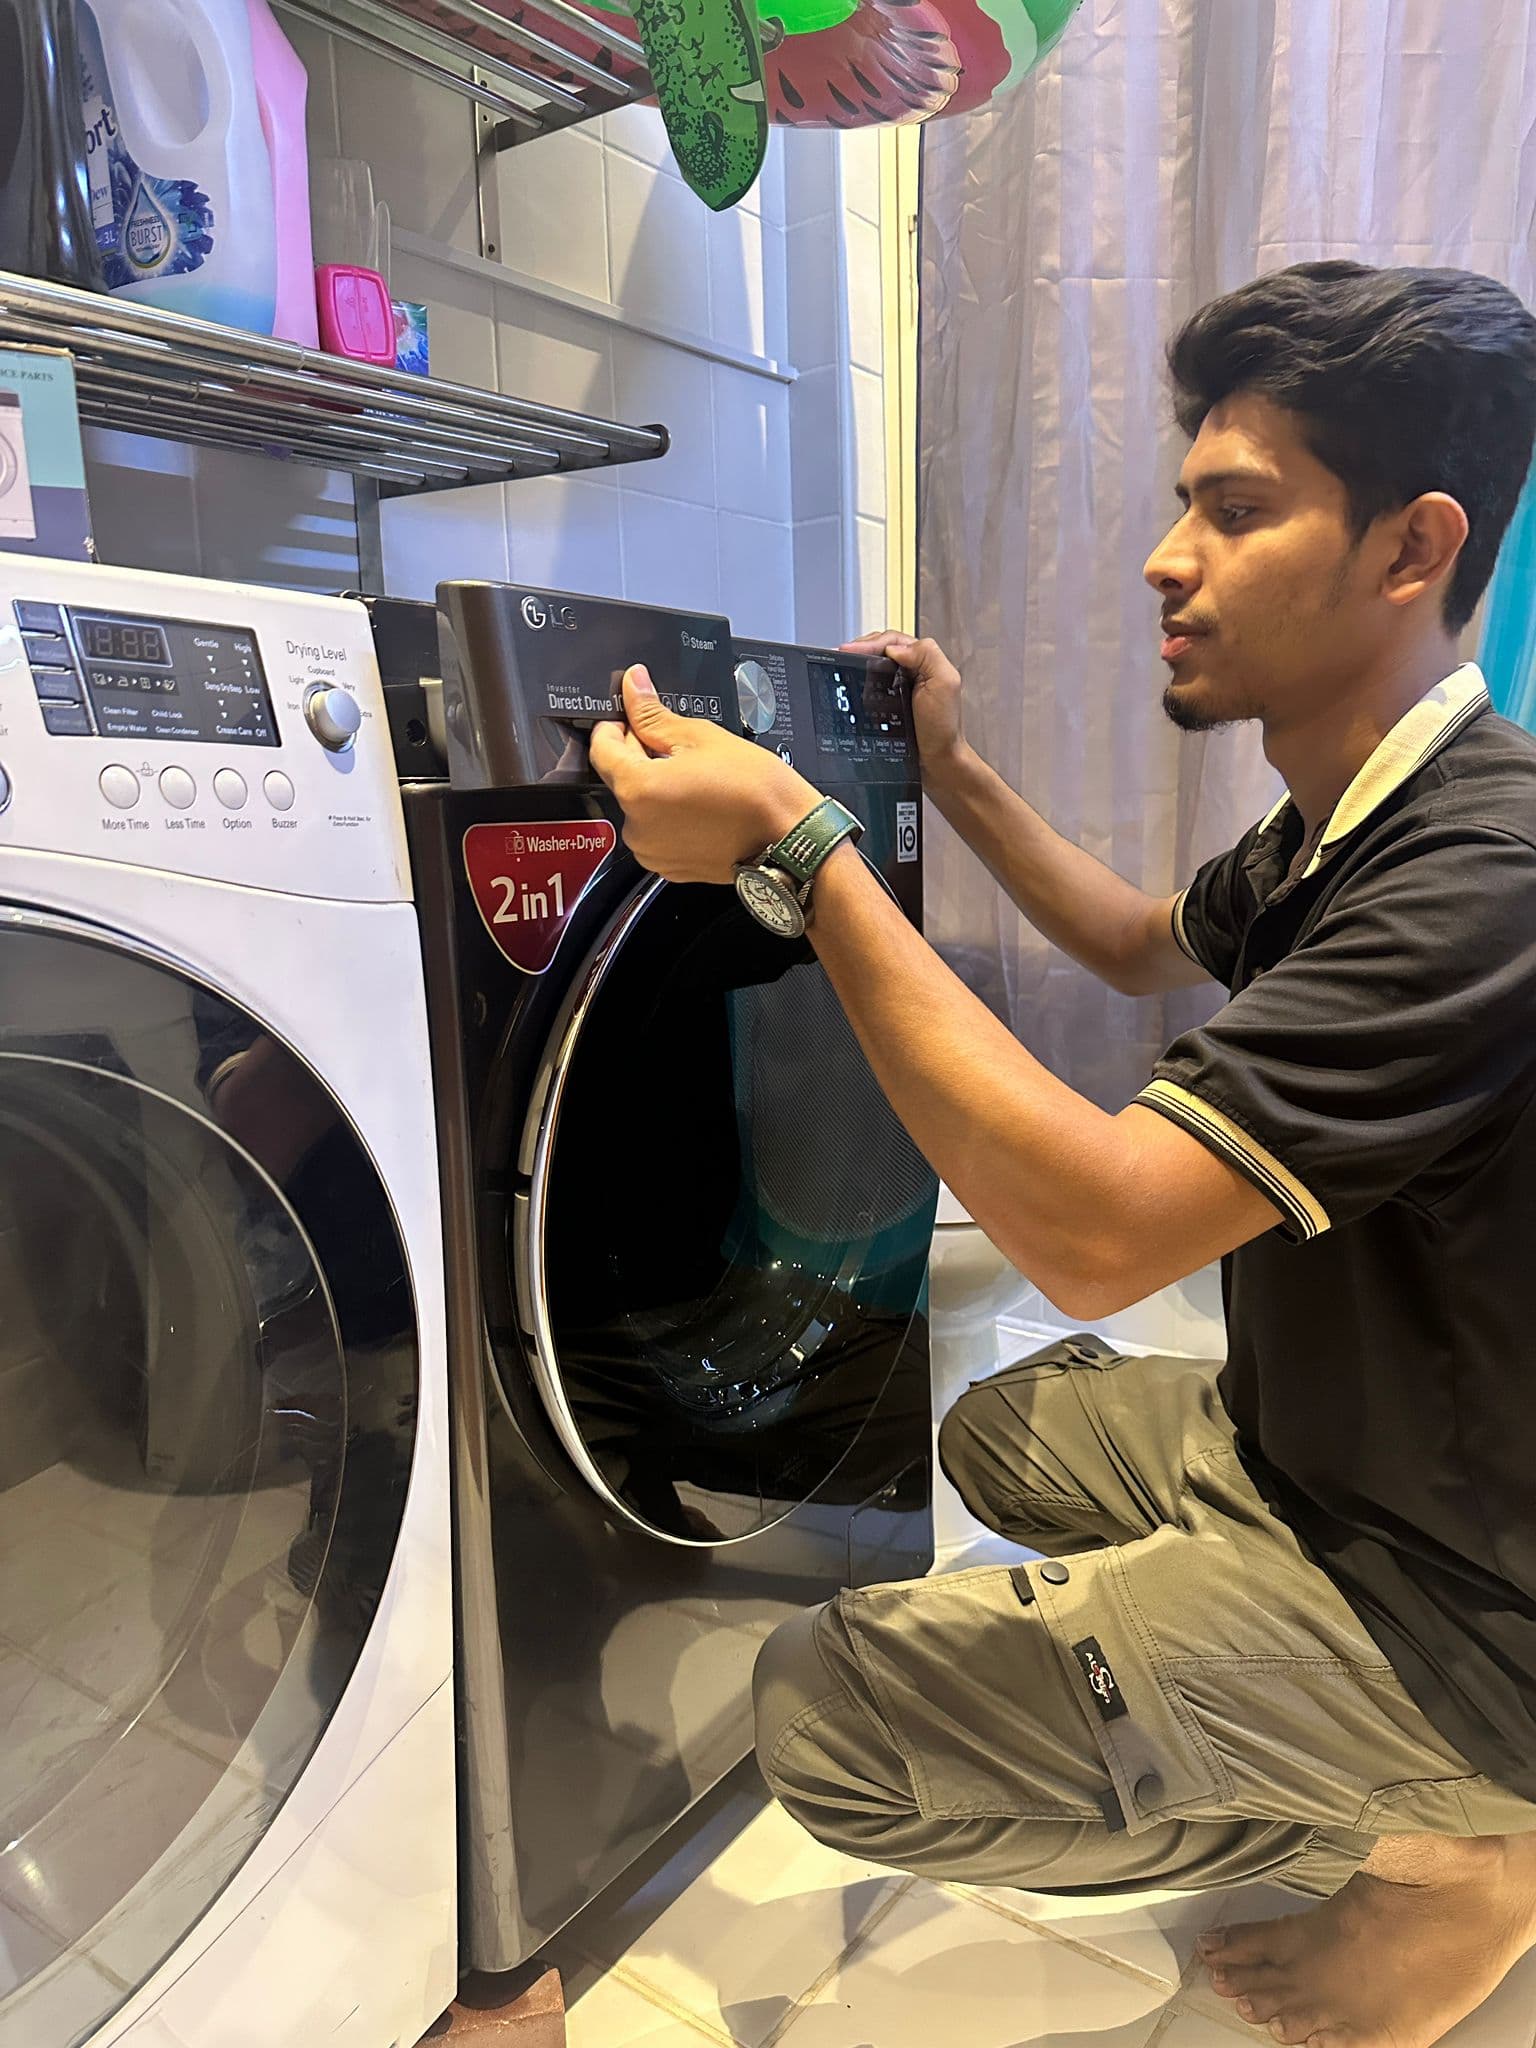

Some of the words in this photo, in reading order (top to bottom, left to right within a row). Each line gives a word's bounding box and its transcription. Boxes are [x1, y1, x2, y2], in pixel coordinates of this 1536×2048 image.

[131, 225, 162, 247] BURST
[549, 604, 577, 631] LG
[193, 637, 219, 648] Gentle
[234, 643, 252, 654] High
[286, 640, 321, 661] Drying
[320, 645, 347, 661] Level
[244, 685, 261, 694] Low
[546, 683, 580, 694] Inverter
[549, 693, 584, 711] Direct
[585, 695, 613, 712] Drive
[102, 818, 126, 830] More
[126, 818, 150, 830] Time
[165, 818, 185, 830] Less
[185, 818, 206, 829] Time
[223, 818, 252, 831] Option
[272, 818, 298, 829] Buzzer
[899, 825, 916, 853] 10
